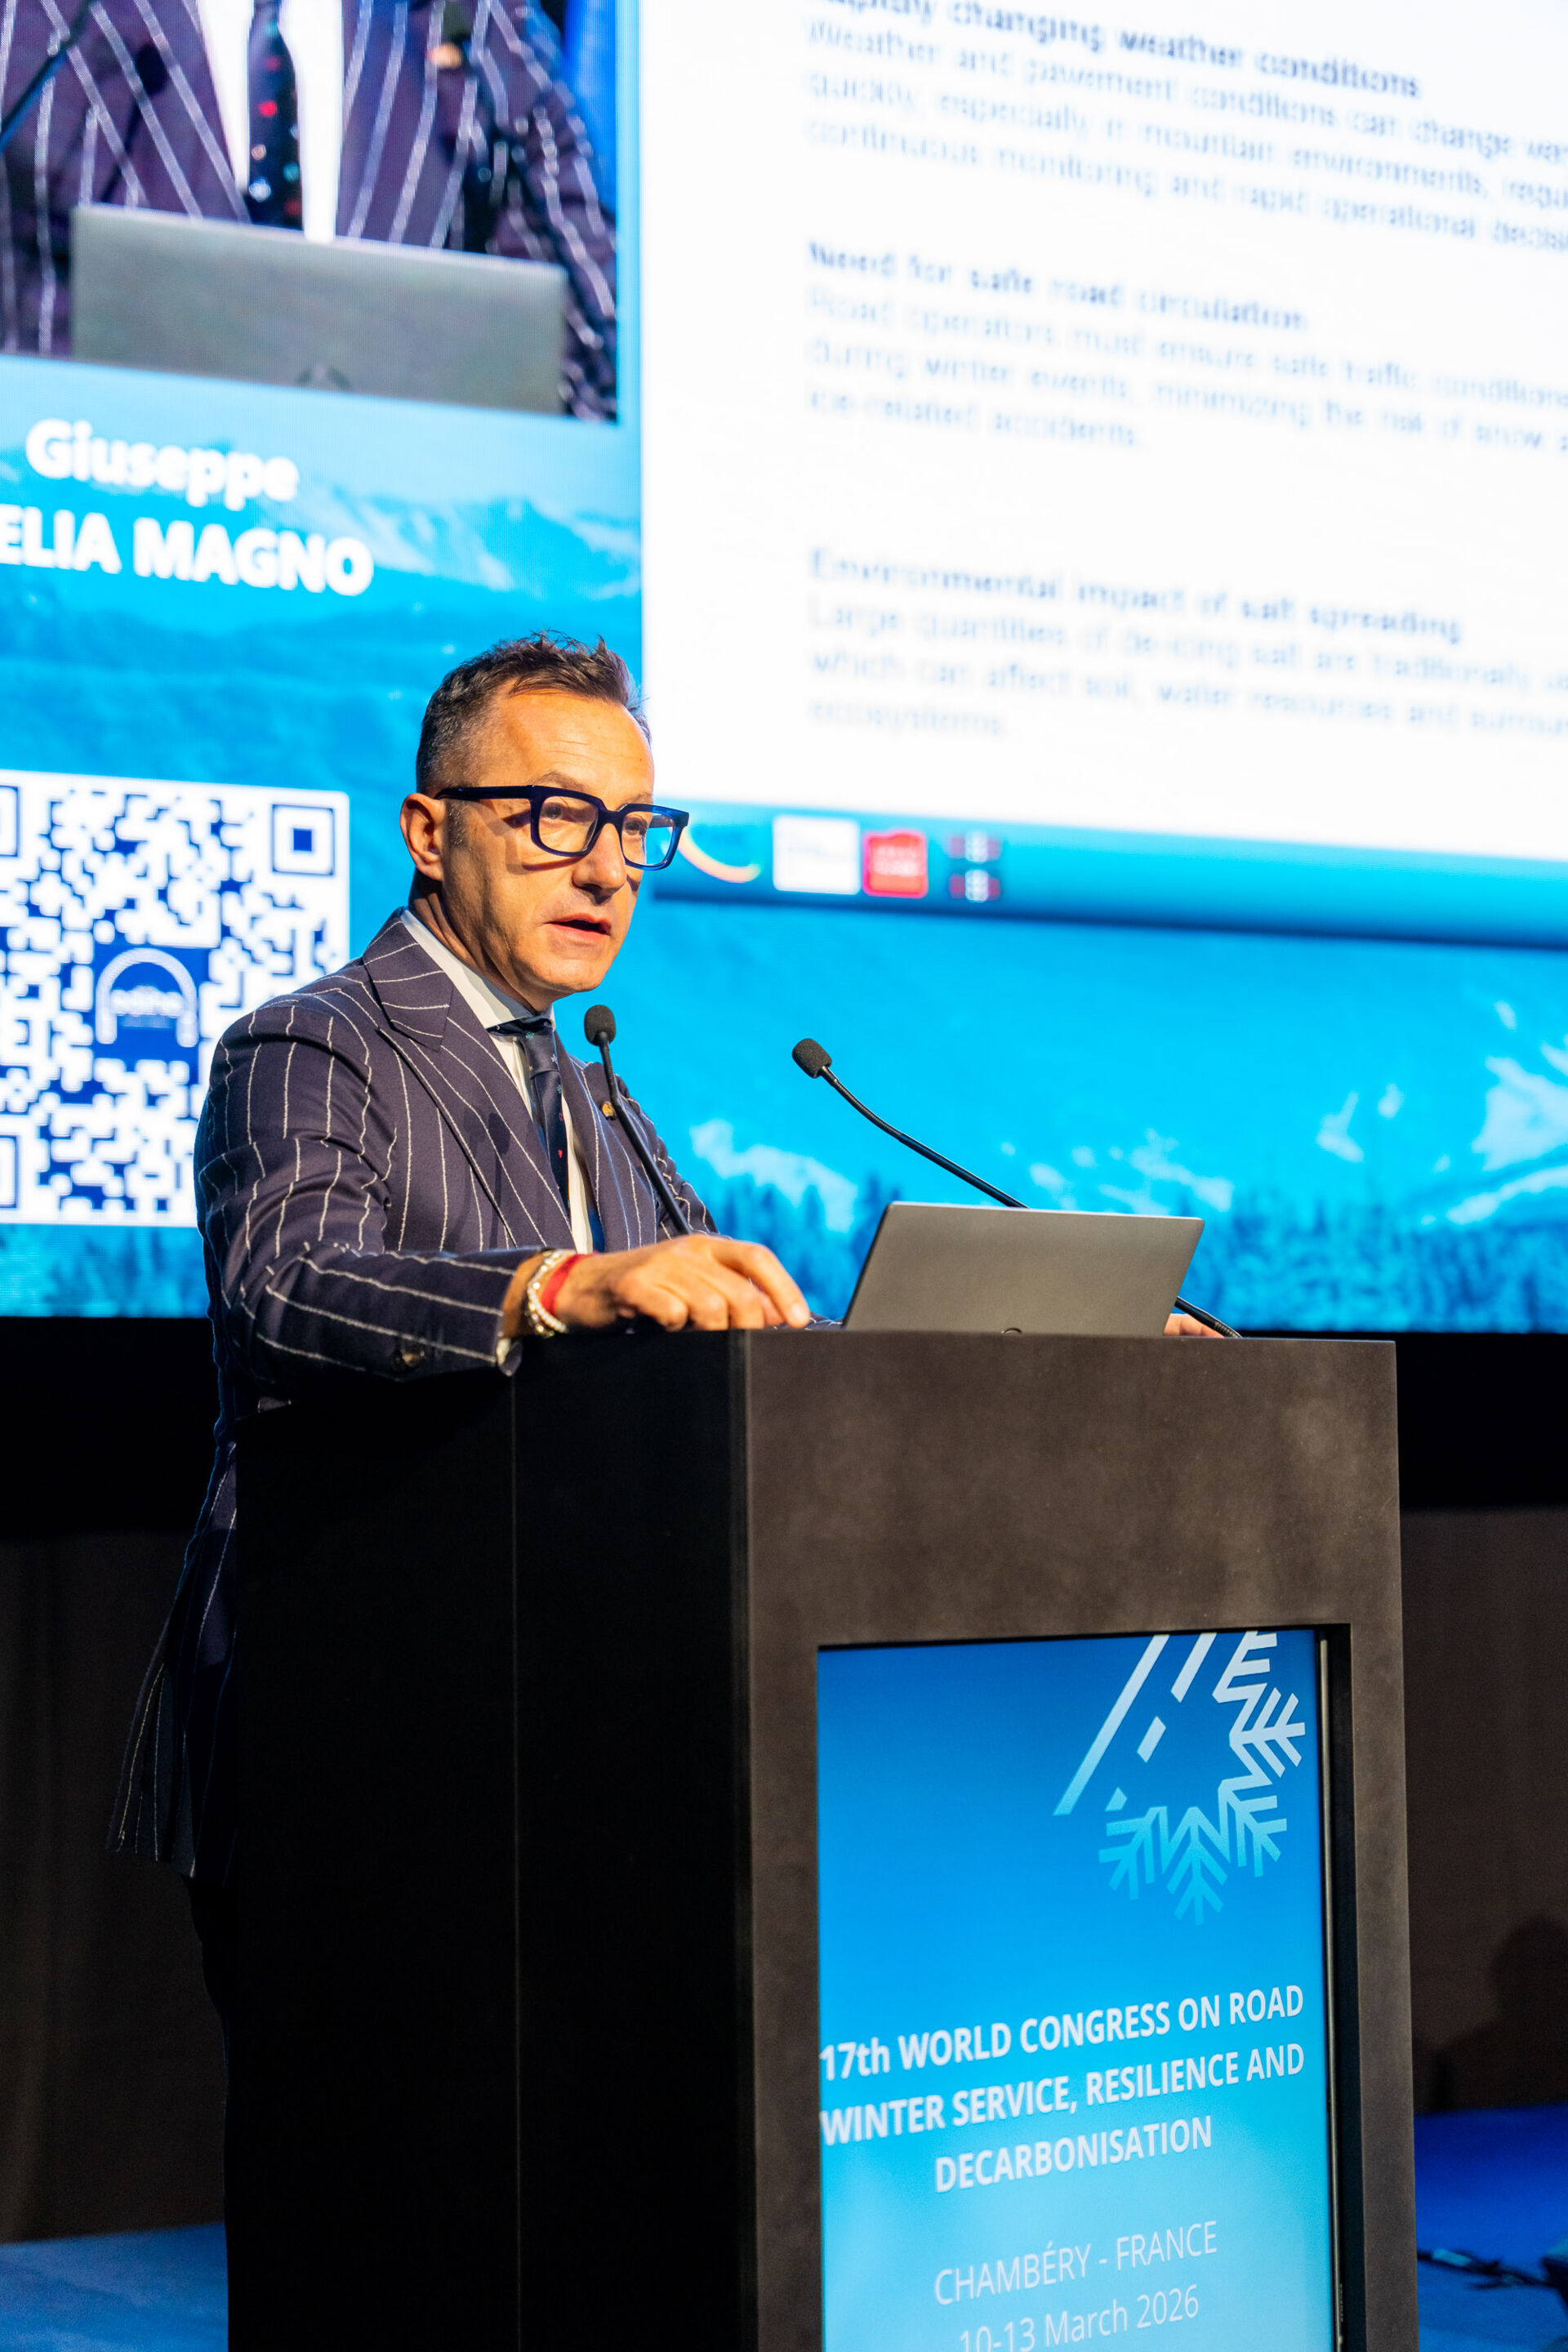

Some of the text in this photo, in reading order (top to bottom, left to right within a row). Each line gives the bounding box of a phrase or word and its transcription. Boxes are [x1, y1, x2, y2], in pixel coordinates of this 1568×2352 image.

[25, 418, 300, 511] Giuseppe
[133, 517, 374, 597] MAGNO
[818, 1984, 1304, 2081] 17th WORLD CONGRESS ON ROAD
[819, 2042, 1305, 2146] WINTER SERVICE, RESILIENCE AND
[935, 2115, 1212, 2193] DECARBONISATION
[933, 2240, 1092, 2305] CHAMBÉRY
[1116, 2220, 1218, 2271] FRANCE
[960, 2284, 1200, 2352] 10-13 March 2026
